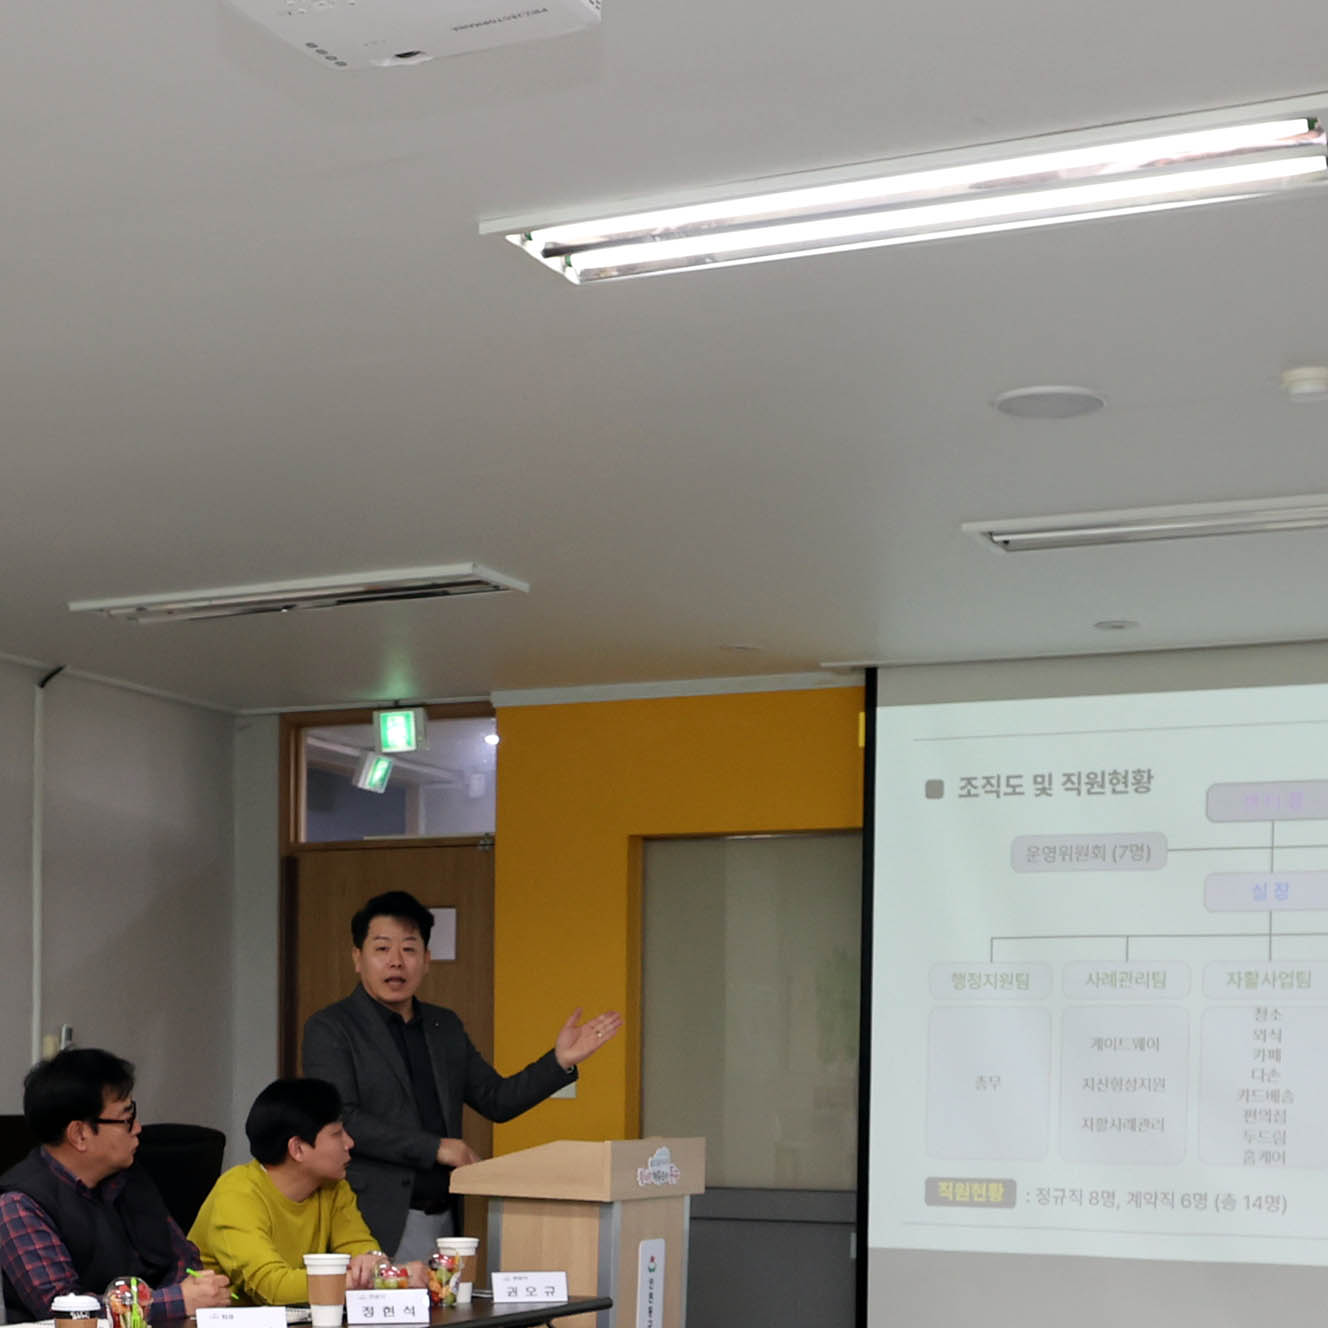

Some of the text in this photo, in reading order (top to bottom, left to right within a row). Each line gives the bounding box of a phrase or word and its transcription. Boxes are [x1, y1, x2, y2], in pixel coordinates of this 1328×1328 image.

[957, 768, 1154, 799] 조직도 및 직원현황
[1024, 842, 1153, 864] 운영위원회 (7명)
[951, 971, 1032, 992] 행정지원팀
[1084, 970, 1168, 991] 사례관리팀
[1225, 970, 1313, 991] 자활사업팀
[1035, 1187, 1084, 1207] 정규직
[1088, 1188, 1120, 1210] 8명,
[1126, 1190, 1176, 1210] 계약직
[1180, 1191, 1209, 1211] 6명
[1242, 1193, 1289, 1214] 14명)
[361, 1305, 416, 1319] 정현석
